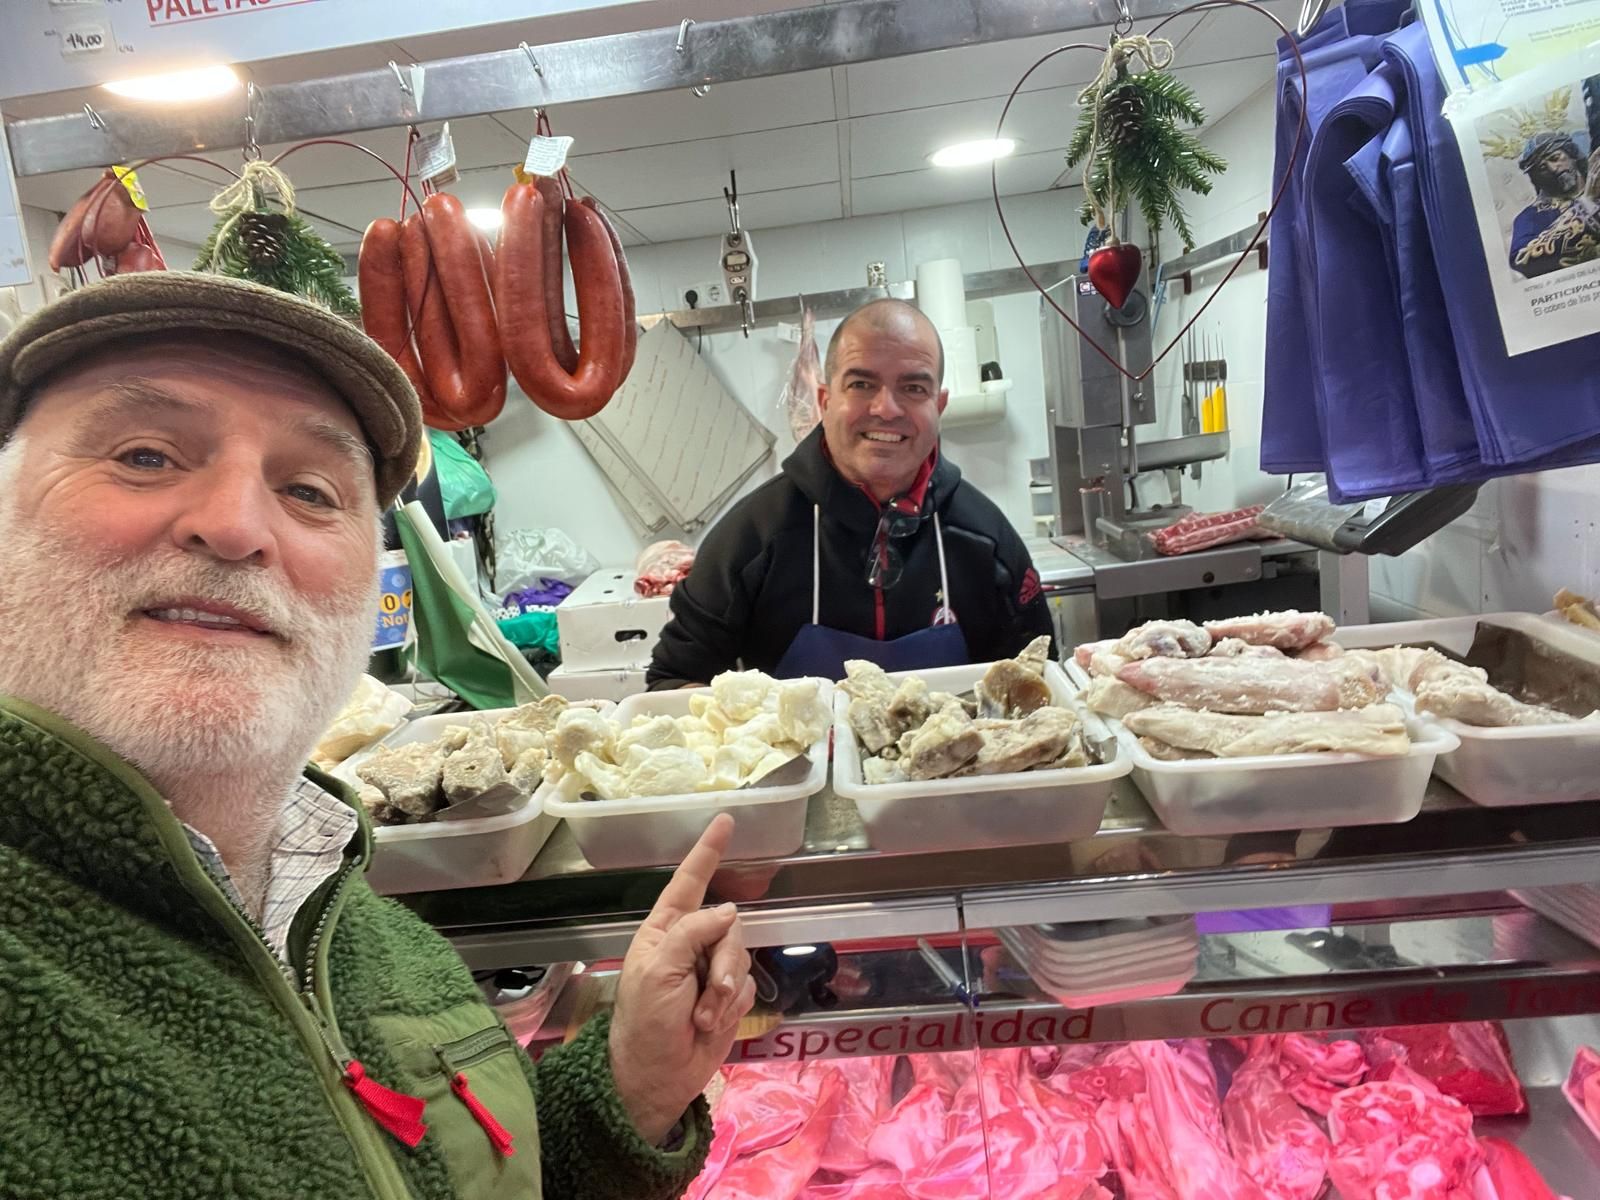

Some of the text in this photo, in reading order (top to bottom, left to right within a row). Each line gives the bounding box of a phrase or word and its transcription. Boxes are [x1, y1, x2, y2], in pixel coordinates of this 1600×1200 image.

[146, 0, 271, 21] PALE
[1567, 297, 1577, 307] de
[1200, 997, 1374, 1033] Carne
[1398, 985, 1469, 1022] de
[740, 1006, 1095, 1061] Especialidad
